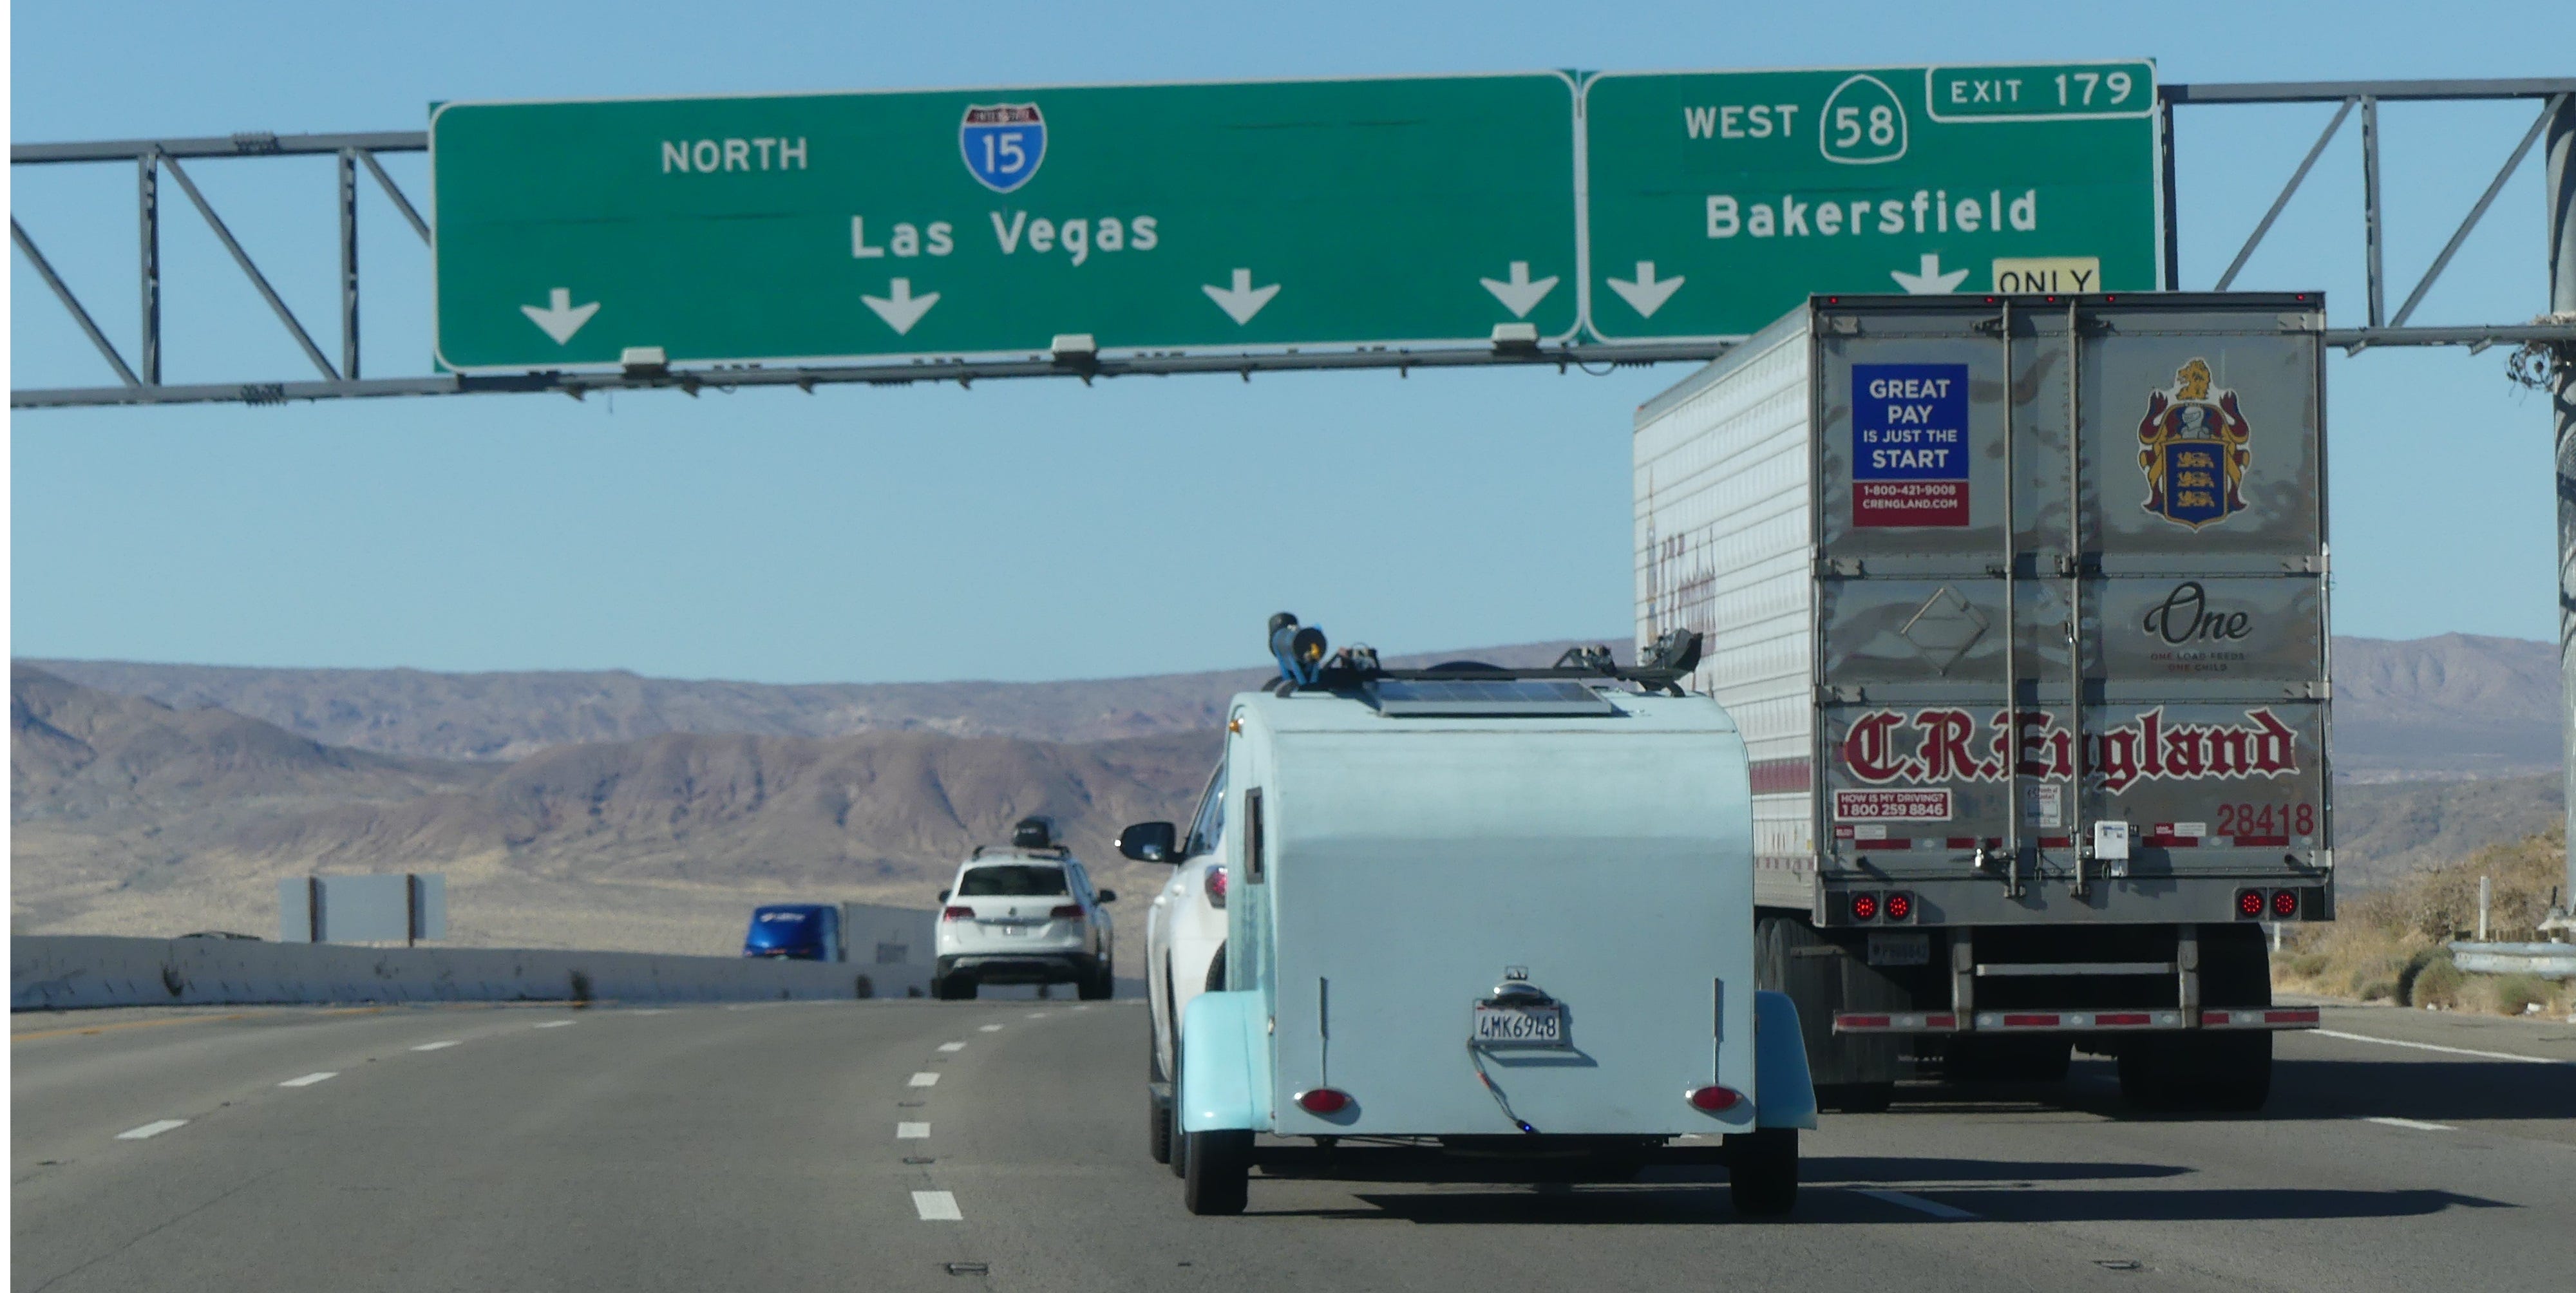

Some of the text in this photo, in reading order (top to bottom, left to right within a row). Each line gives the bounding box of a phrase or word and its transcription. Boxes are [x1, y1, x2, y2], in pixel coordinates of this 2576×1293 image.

[1950, 72, 2132, 106] EXIT 179
[1685, 104, 1895, 147] WEST 58
[661, 137, 808, 174] NORTH
[982, 133, 1026, 173] 15
[1707, 189, 2036, 239] Bakersfield
[851, 209, 1159, 267] Las Vegas
[1869, 379, 1951, 399] GREAT
[1888, 404, 1933, 425] PAY
[1863, 429, 1958, 443] IS JUST THE
[1872, 449, 1949, 469] START
[1863, 485, 1956, 496] 1-800-421-9008
[1862, 498, 1958, 509] CRENGLAND.COM
[2143, 581, 2253, 645] One
[1841, 793, 1944, 803] HOW IS MY DRIVING?
[1842, 804, 1944, 816] 1 800 259 8846
[2217, 803, 2314, 836] 28418
[1481, 1014, 1557, 1039] 4MK6948
